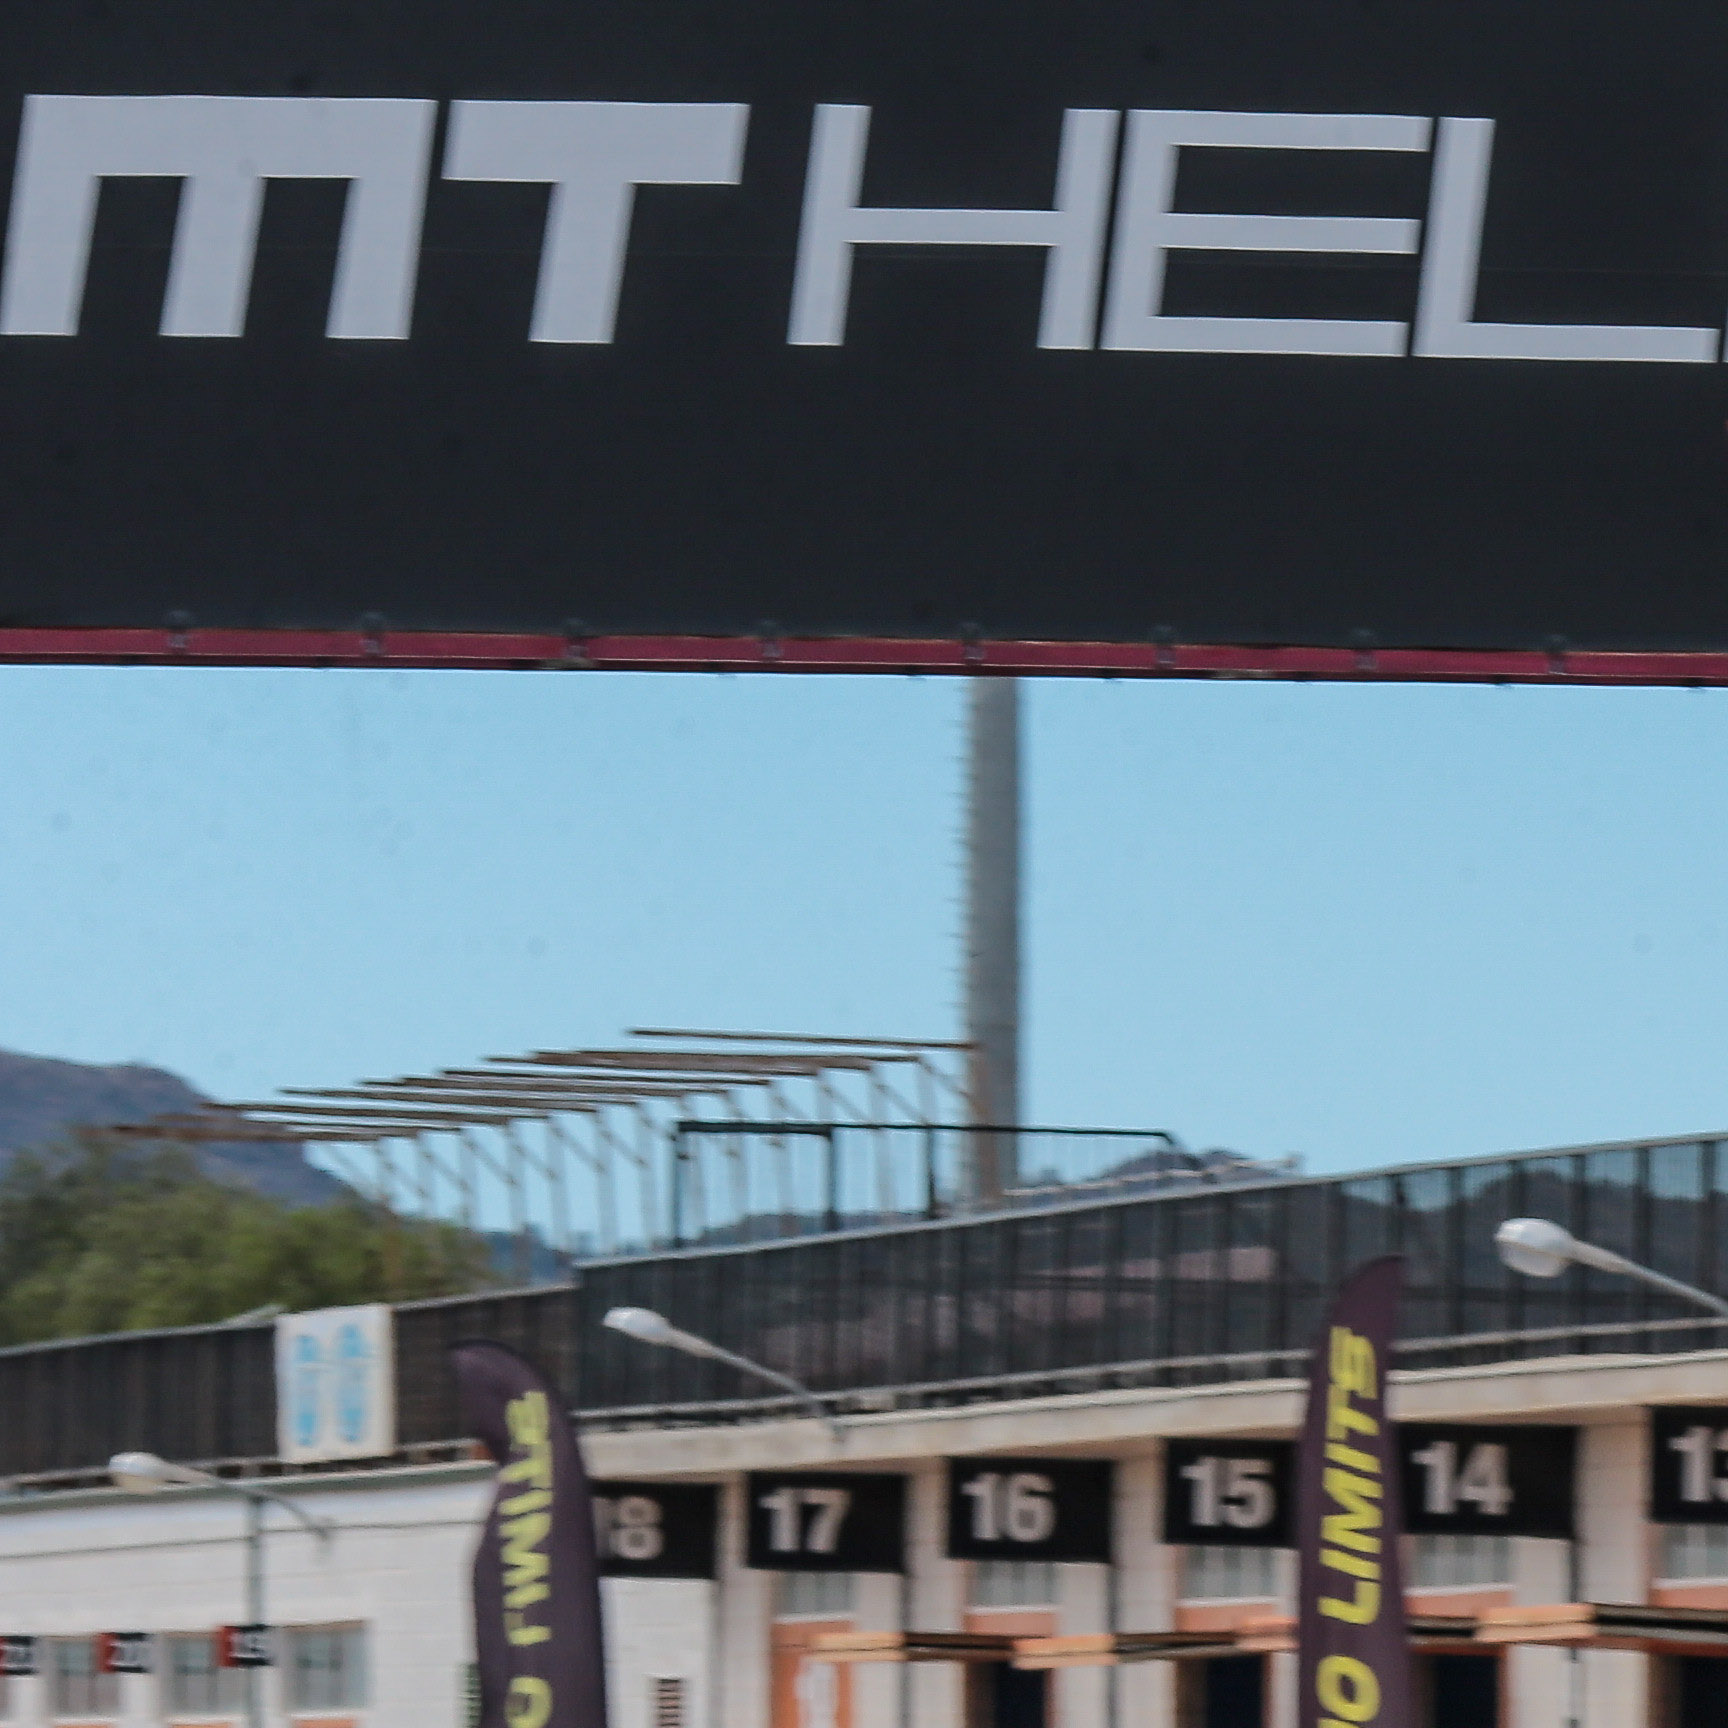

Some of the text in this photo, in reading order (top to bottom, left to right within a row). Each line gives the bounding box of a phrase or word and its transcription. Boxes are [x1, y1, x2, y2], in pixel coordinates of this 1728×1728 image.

[0, 94, 750, 344] MT
[962, 1473, 1056, 1543] 16
[1180, 1456, 1275, 1529] 15
[1317, 1326, 1384, 1625] LIMITS
[1410, 1442, 1513, 1515] 14
[759, 1487, 849, 1552] 17
